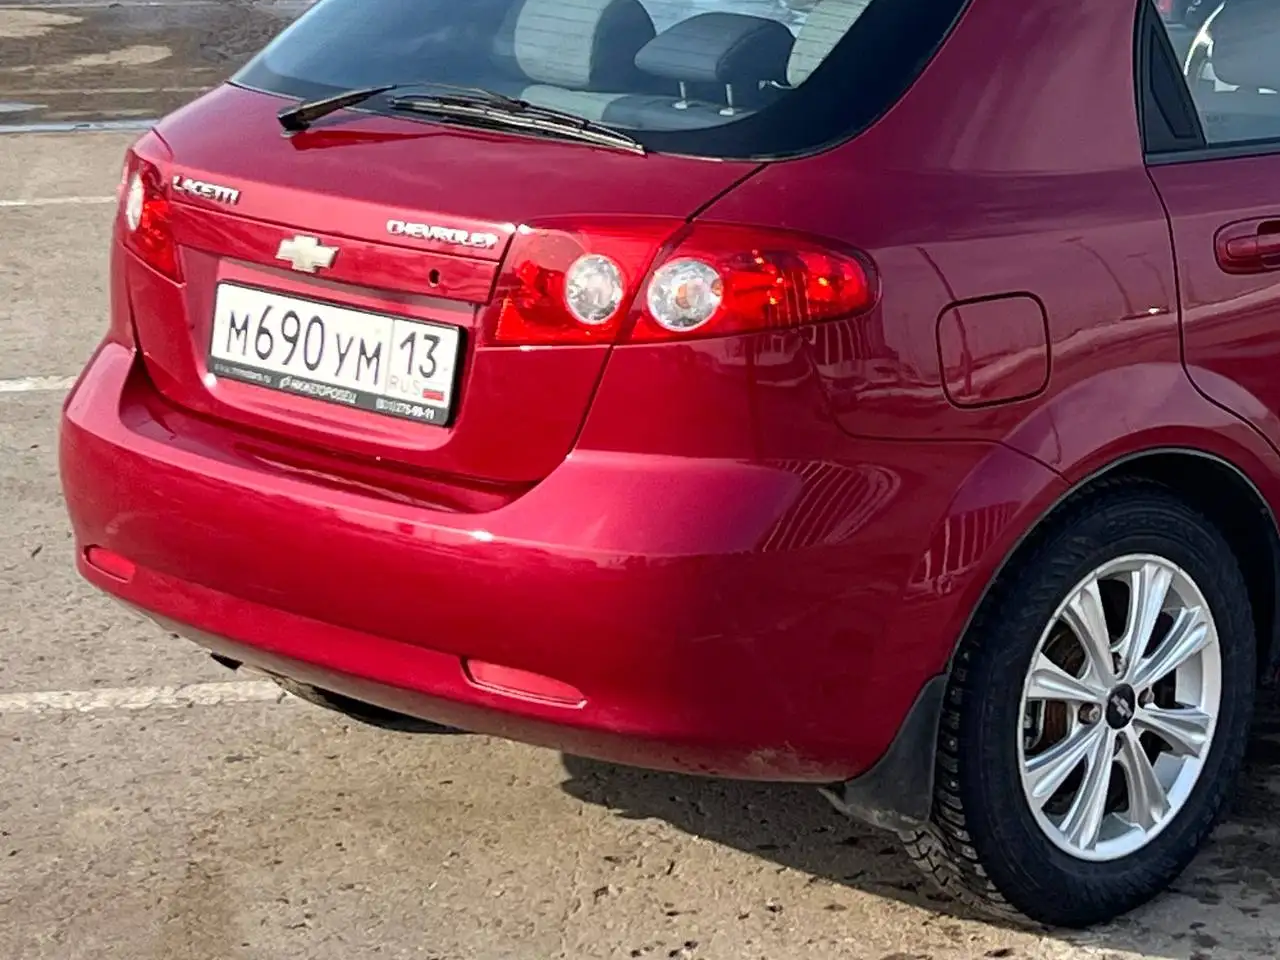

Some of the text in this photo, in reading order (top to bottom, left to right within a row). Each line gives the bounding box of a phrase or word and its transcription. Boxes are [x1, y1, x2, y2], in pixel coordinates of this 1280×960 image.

[172, 175, 242, 205] LACETTI
[386, 219, 500, 250] CHEVROLET
[399, 330, 441, 379] 13
[387, 374, 422, 396] RUS
